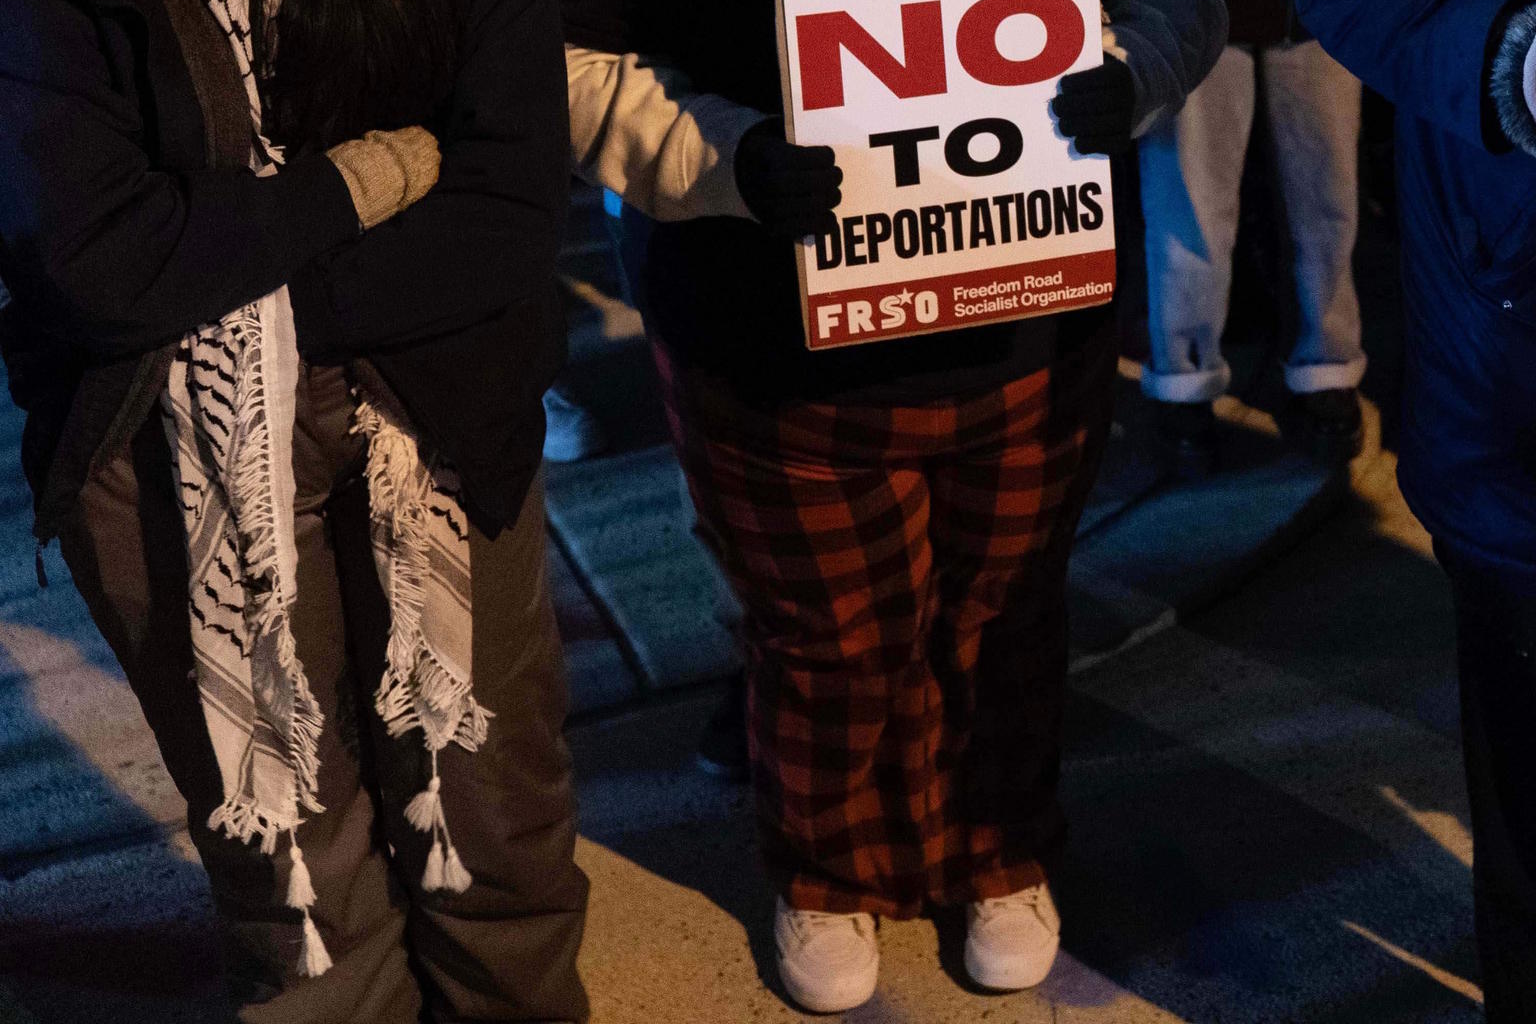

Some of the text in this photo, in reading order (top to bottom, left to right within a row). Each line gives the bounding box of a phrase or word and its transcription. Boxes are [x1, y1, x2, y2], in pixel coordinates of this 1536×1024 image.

[869, 117, 1024, 188] TO
[814, 182, 1104, 271] DEPORTATIONS
[817, 271, 1063, 339] FRSO Freedom Road
[954, 281, 1113, 318] Socialist Organization
